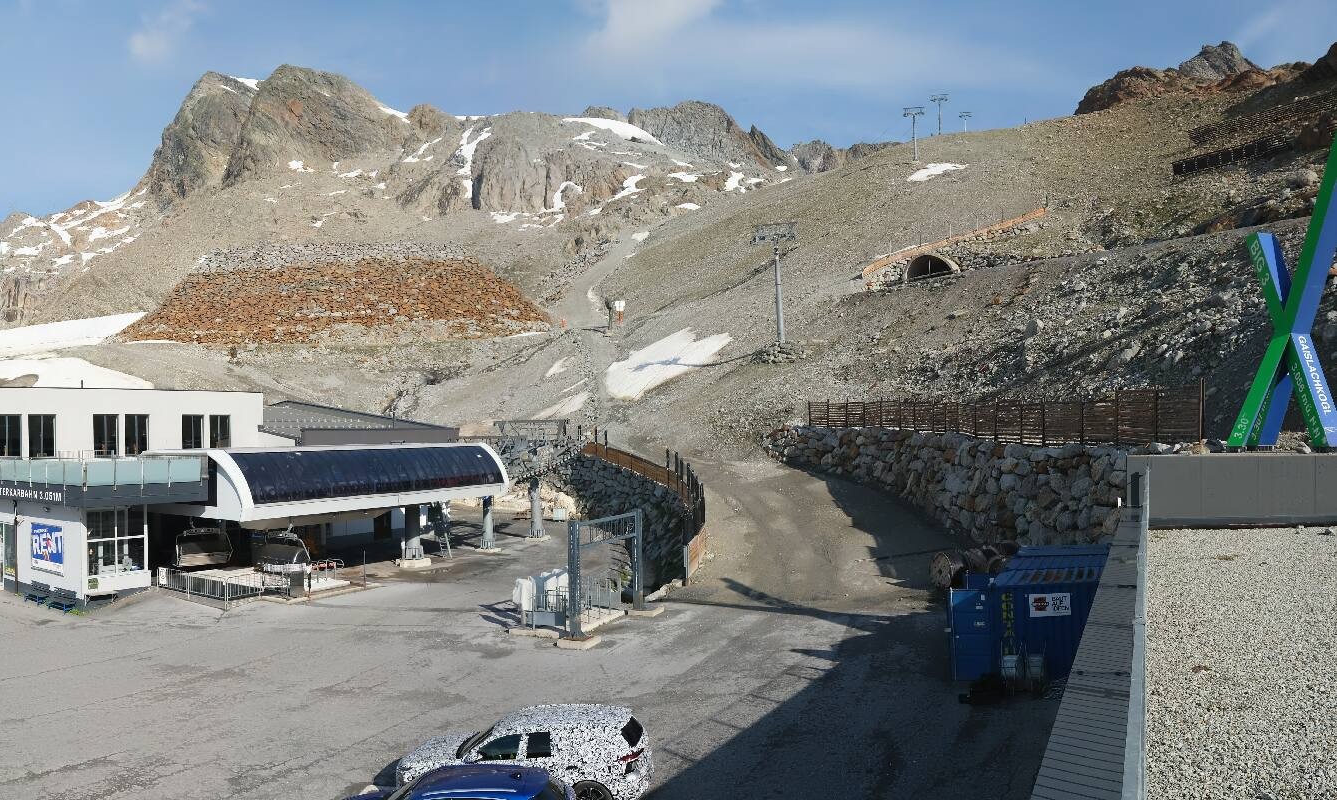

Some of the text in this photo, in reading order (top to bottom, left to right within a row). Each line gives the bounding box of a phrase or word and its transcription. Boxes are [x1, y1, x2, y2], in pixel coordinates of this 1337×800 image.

[1250, 239, 1270, 286] BIG 3
[1298, 335, 1332, 416] GAISLACHKOGL
[32, 531, 62, 555] RENT
